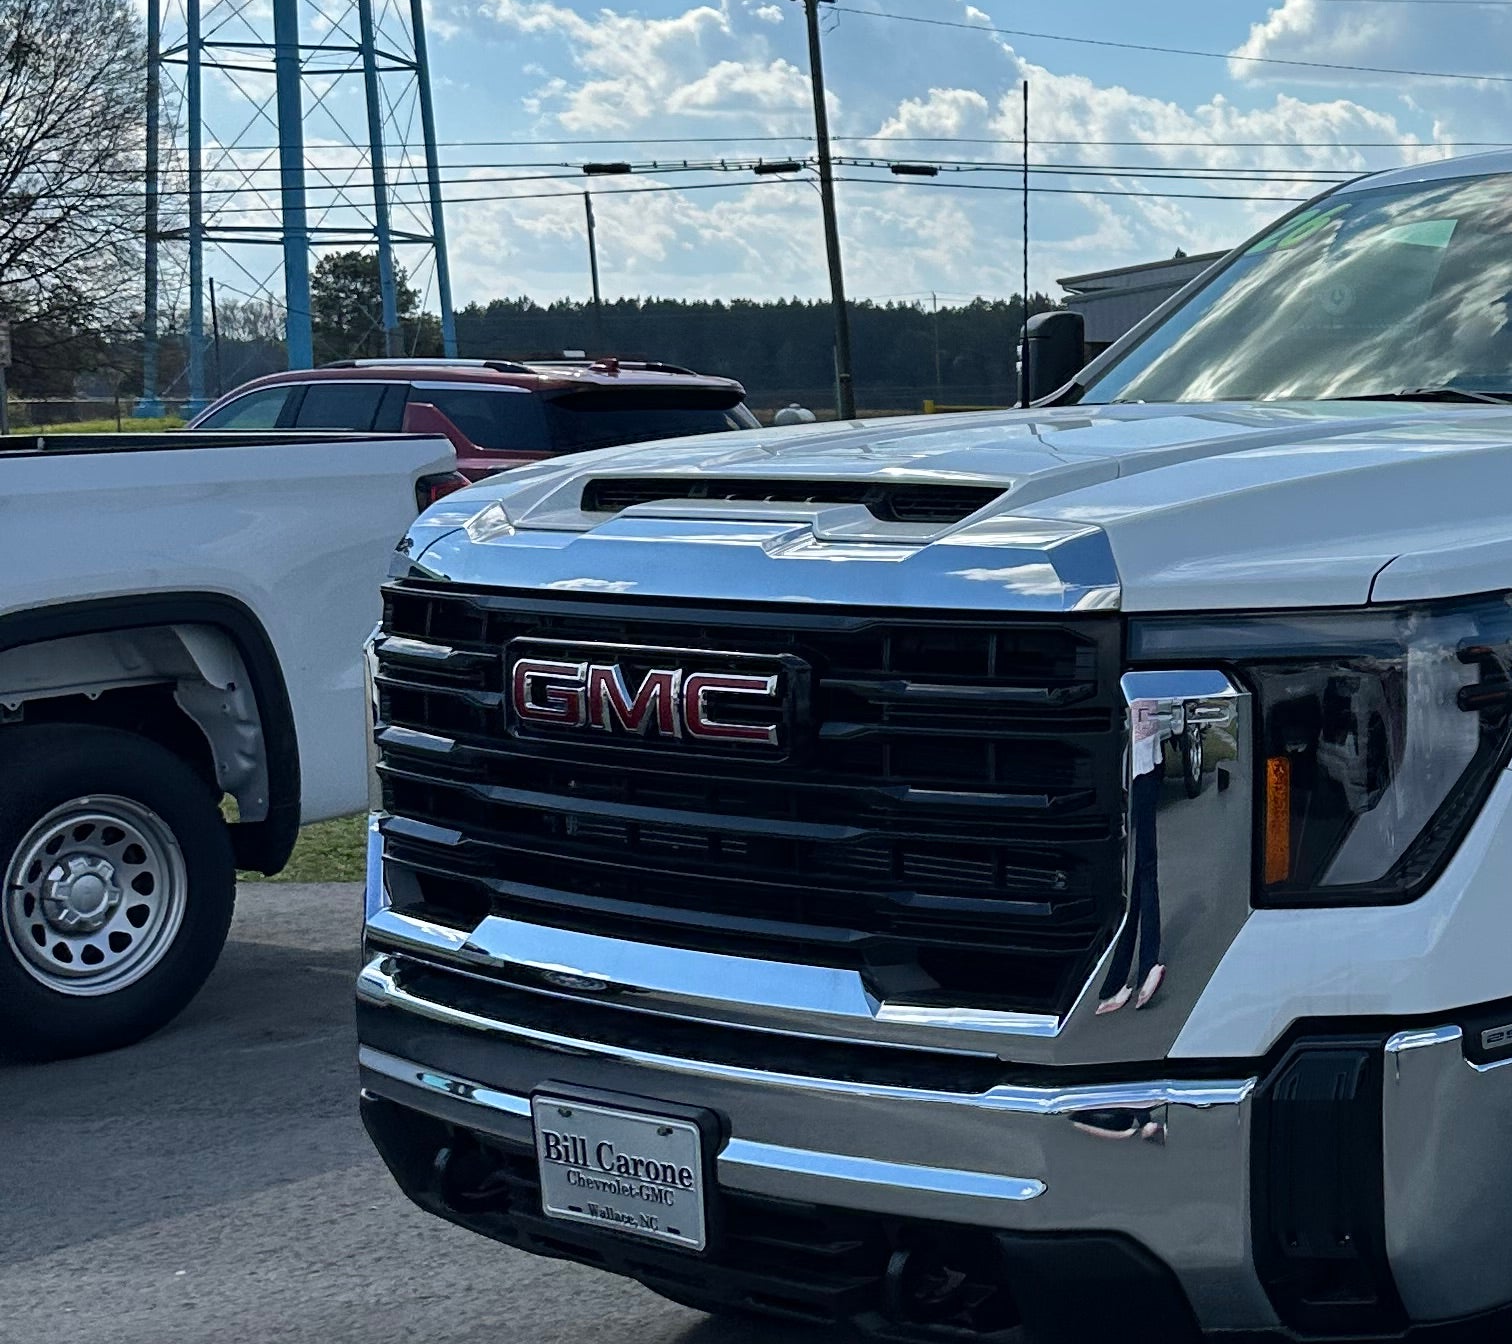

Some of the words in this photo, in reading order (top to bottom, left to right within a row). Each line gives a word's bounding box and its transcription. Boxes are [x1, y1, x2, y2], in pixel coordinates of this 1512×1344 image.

[512, 658, 778, 746] GMC
[543, 1131, 590, 1166] Bill
[596, 1141, 693, 1187] Carone
[567, 1170, 674, 1206] Chevrolet-GMC
[640, 1214, 659, 1231] NC
